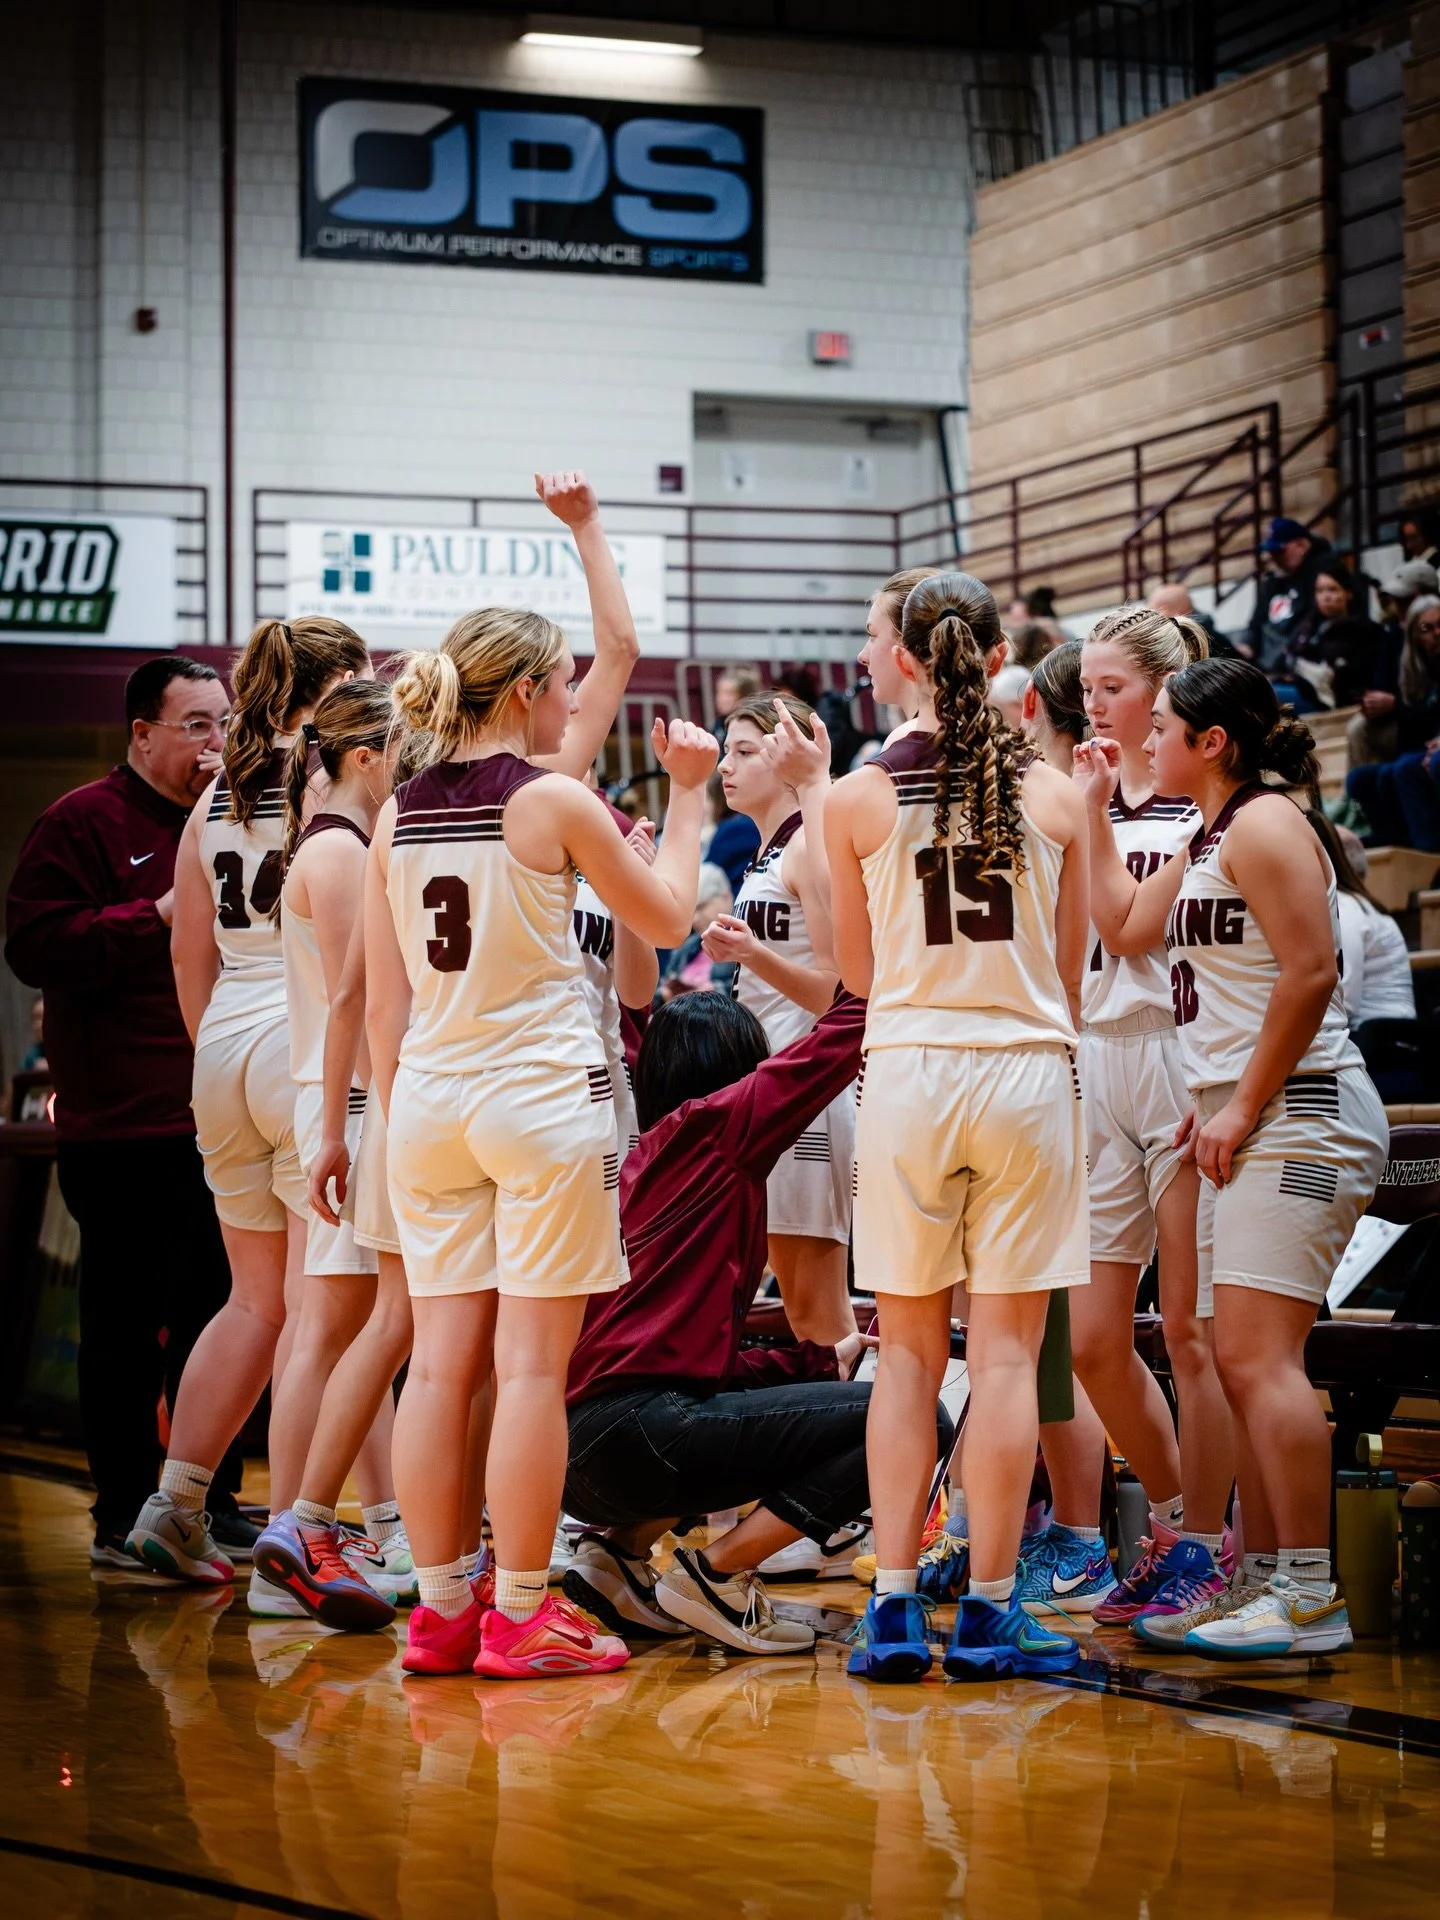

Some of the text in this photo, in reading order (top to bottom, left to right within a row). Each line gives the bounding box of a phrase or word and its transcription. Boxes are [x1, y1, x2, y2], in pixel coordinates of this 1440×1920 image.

[315, 100, 751, 241] OPS
[318, 226, 749, 273] OPTIMUM PERFORMANCE SPORTS
[423, 876, 472, 973] 3
[914, 845, 1014, 946] 15
